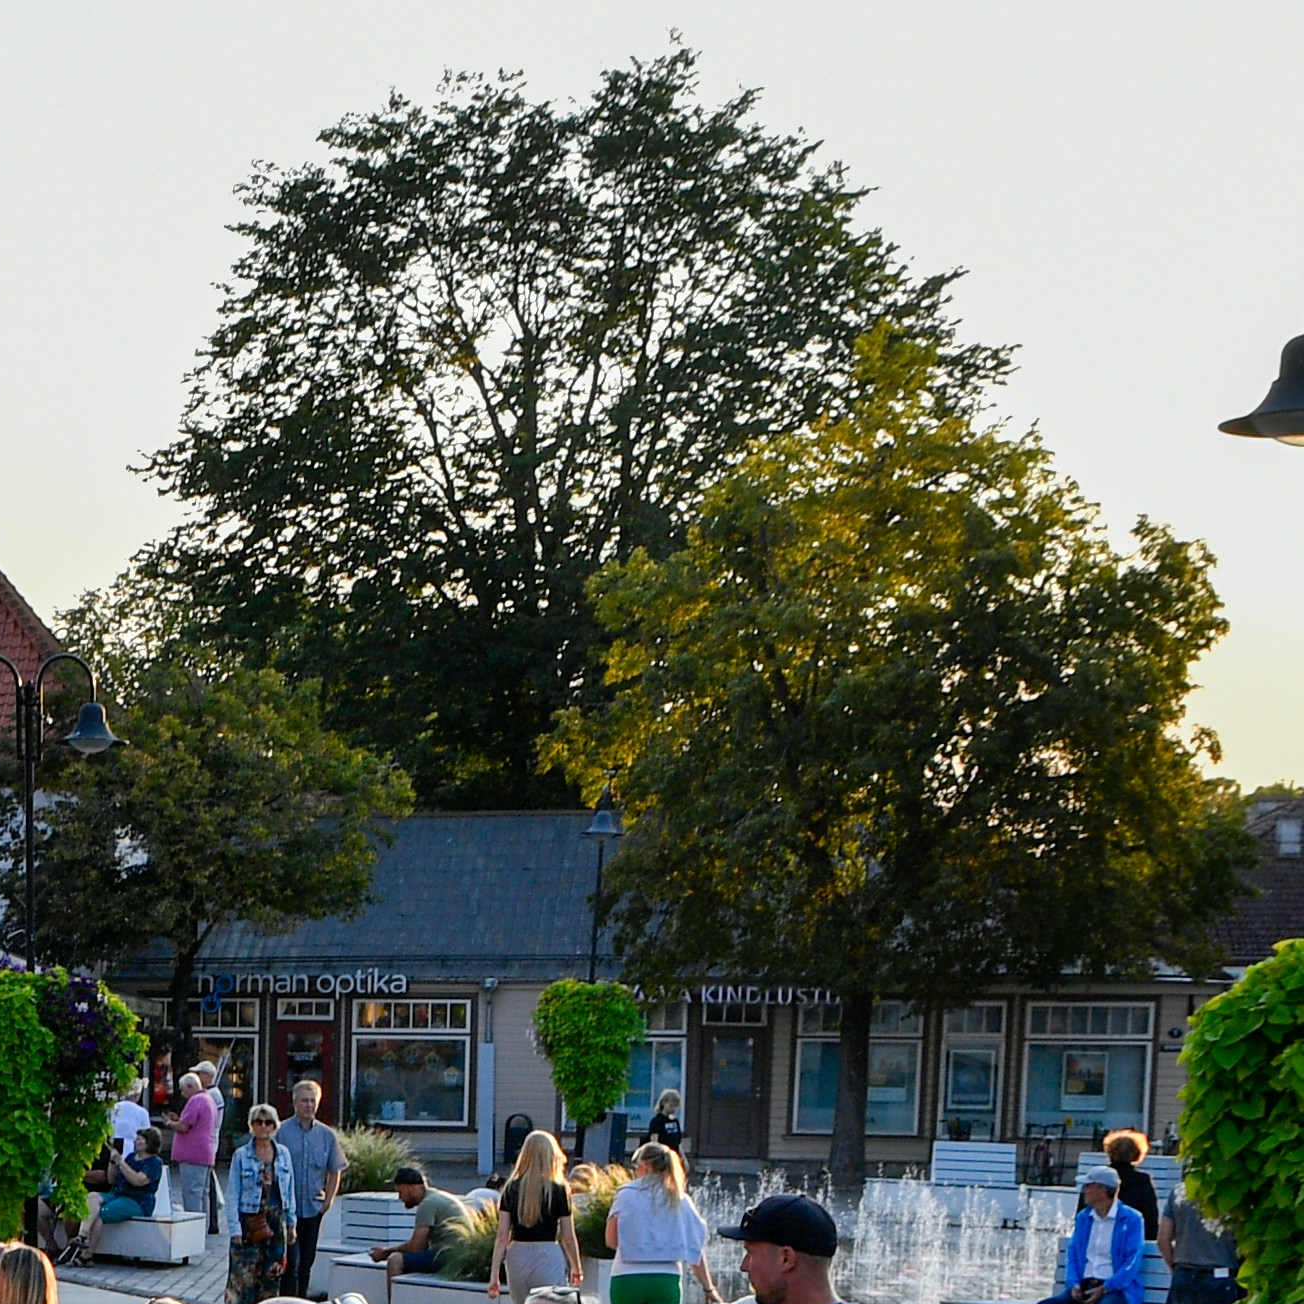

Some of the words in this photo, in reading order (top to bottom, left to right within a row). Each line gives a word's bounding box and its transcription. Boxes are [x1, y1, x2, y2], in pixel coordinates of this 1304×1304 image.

[197, 972, 309, 1012] norman
[315, 966, 408, 1000] optika
[700, 984, 841, 1005] KINDLUSTU
